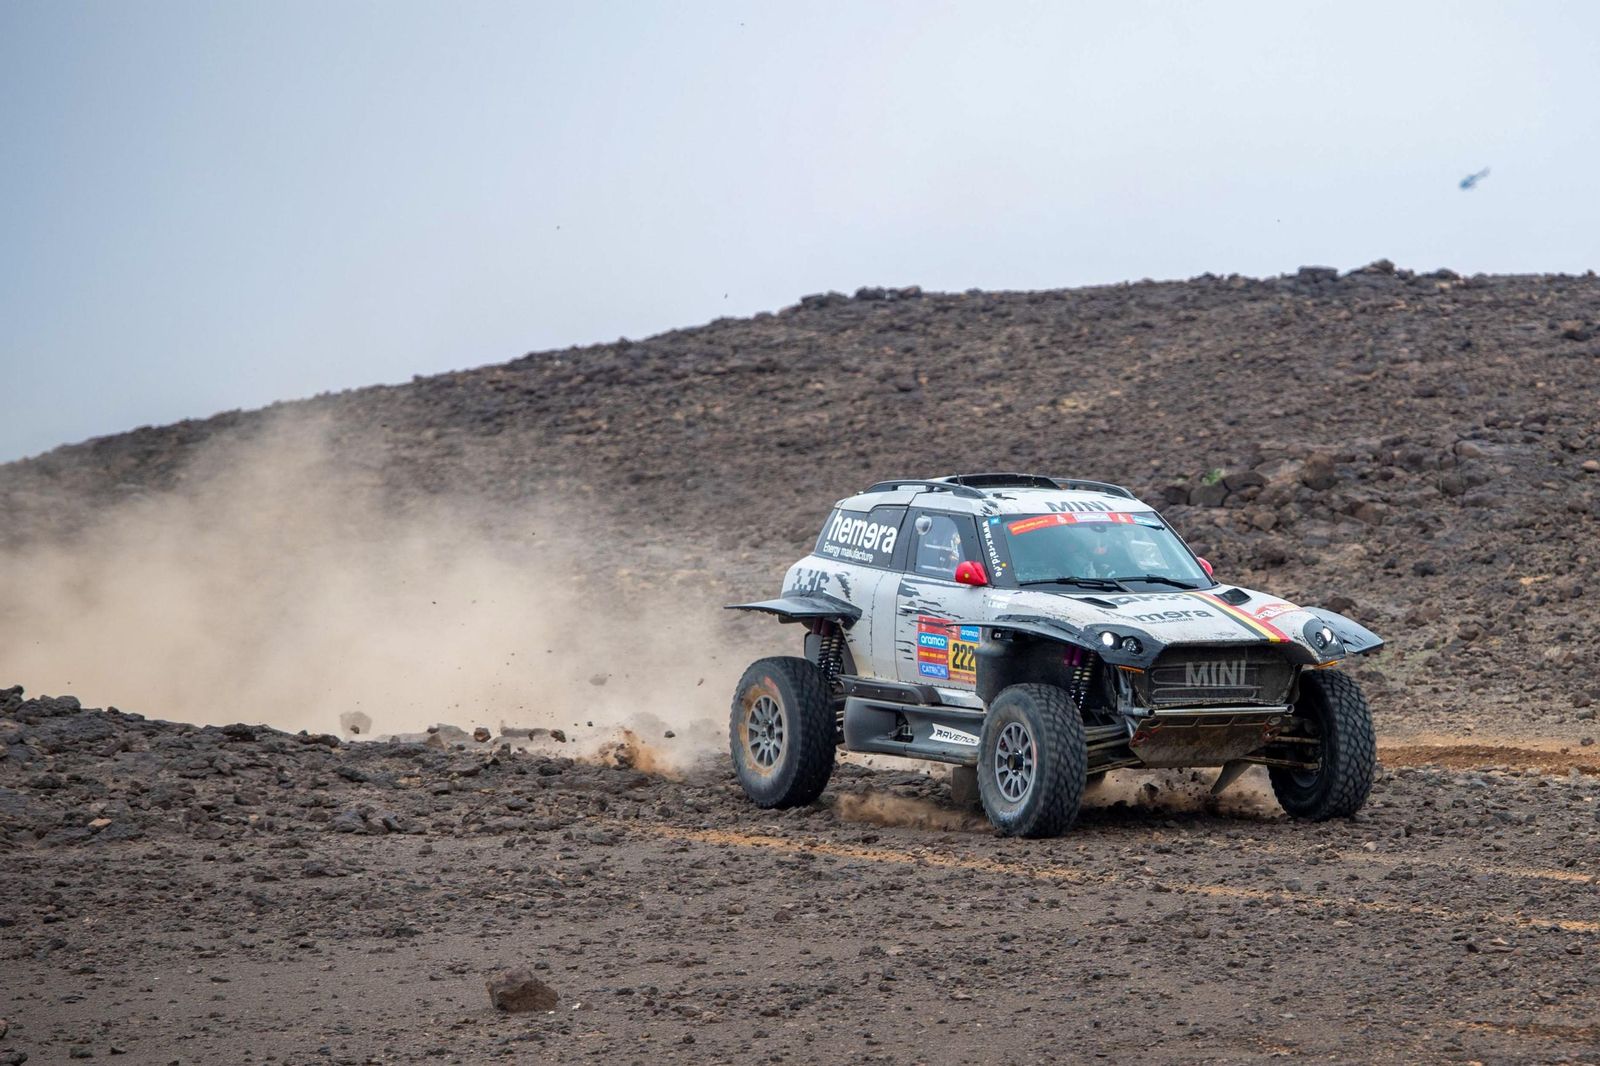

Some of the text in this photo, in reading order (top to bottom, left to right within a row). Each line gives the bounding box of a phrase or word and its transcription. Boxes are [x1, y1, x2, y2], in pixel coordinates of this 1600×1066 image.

[1045, 501, 1114, 513] MINI
[827, 509, 898, 554] hemera
[823, 541, 874, 563] Energy manufacture
[982, 520, 1003, 577] www.x-raid.de
[1134, 609, 1215, 622] mera
[920, 635, 945, 646] aramco
[952, 642, 976, 672] 222
[1185, 660, 1247, 687] MINI
